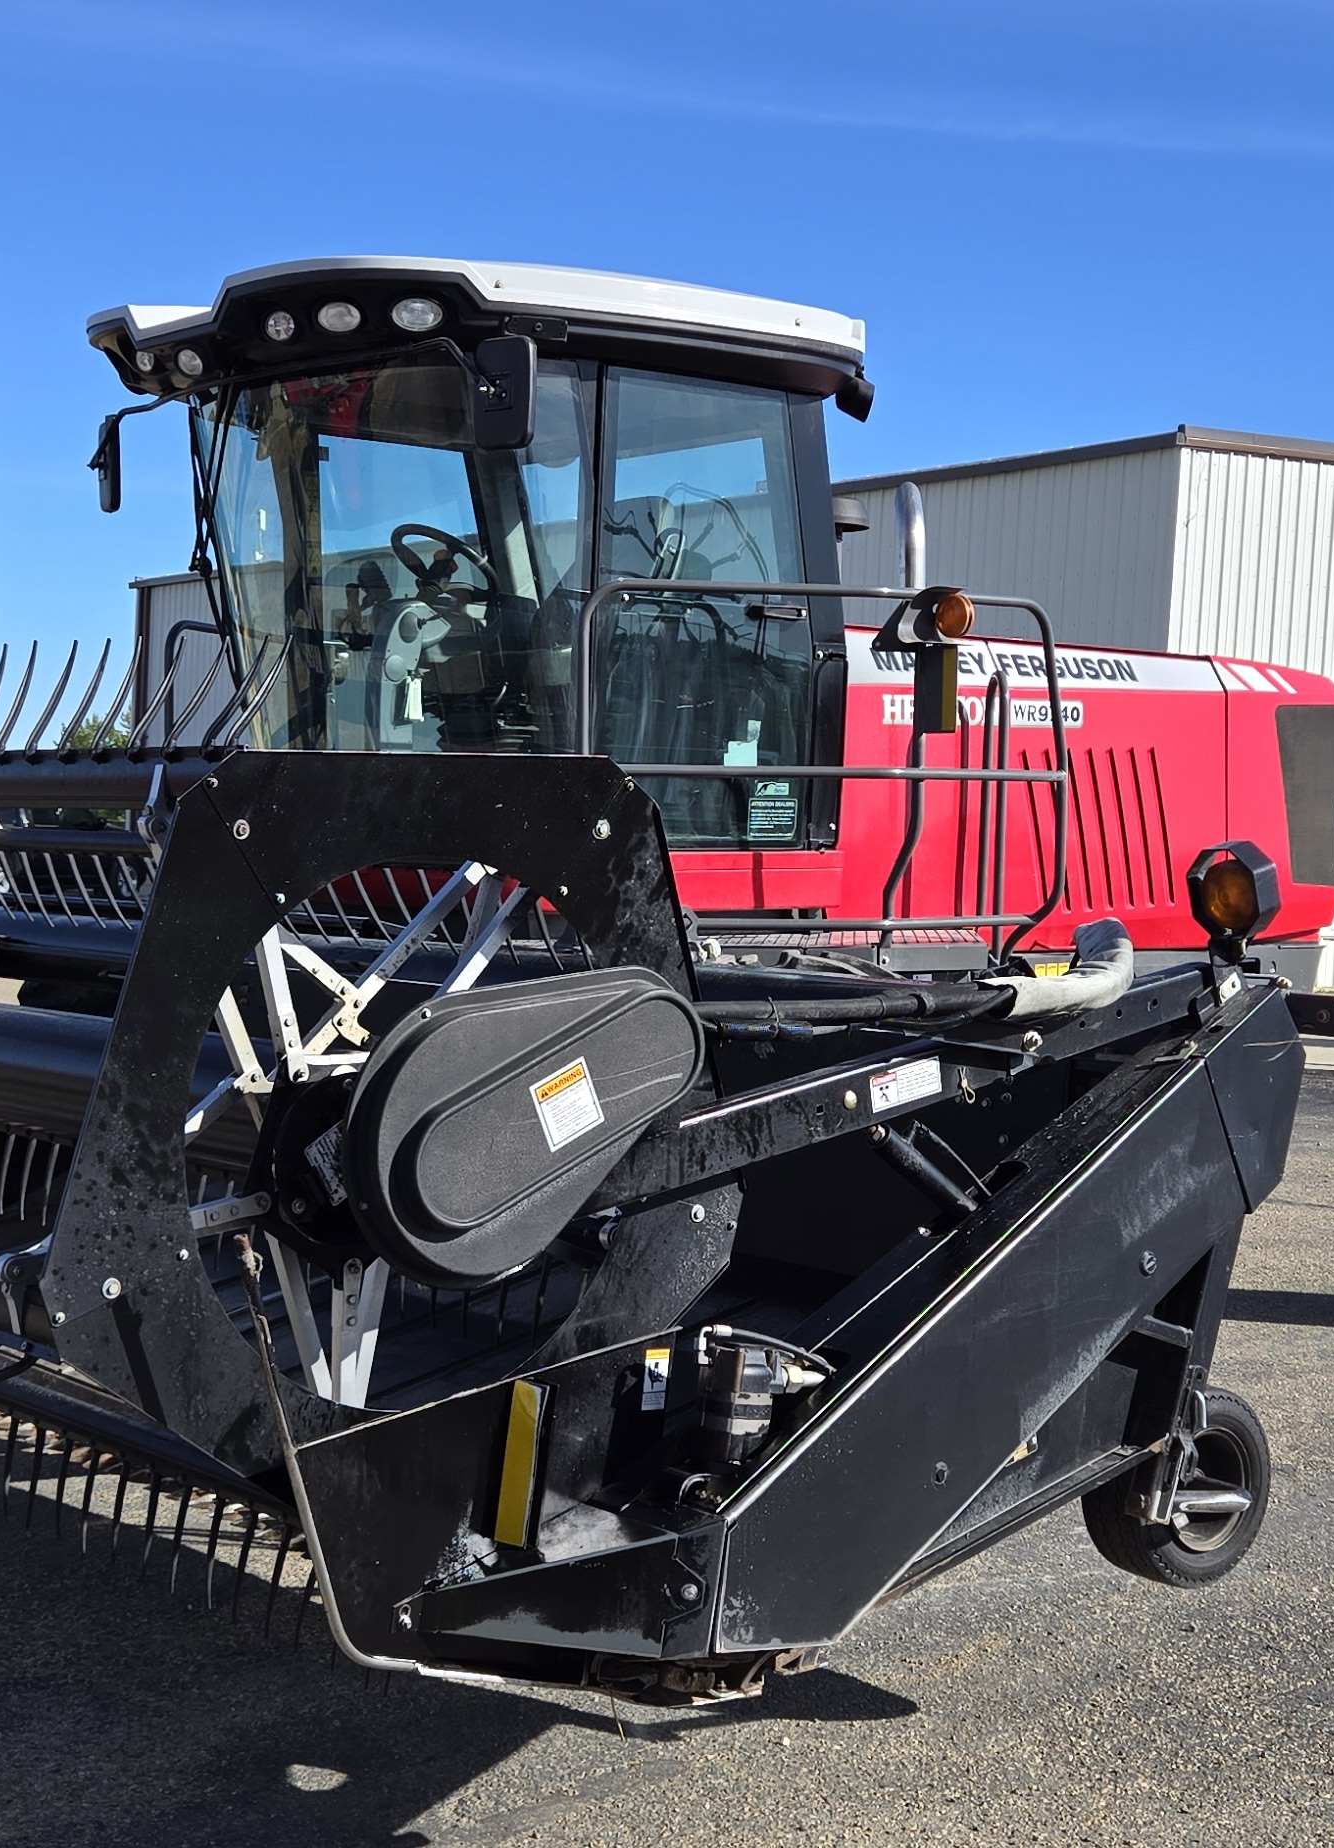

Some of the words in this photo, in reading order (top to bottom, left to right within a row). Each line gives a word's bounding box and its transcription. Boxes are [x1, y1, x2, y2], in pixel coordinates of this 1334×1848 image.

[870, 648, 987, 675] MAEY
[1013, 704, 1080, 722] WR940
[547, 1069, 582, 1094] WARNING
